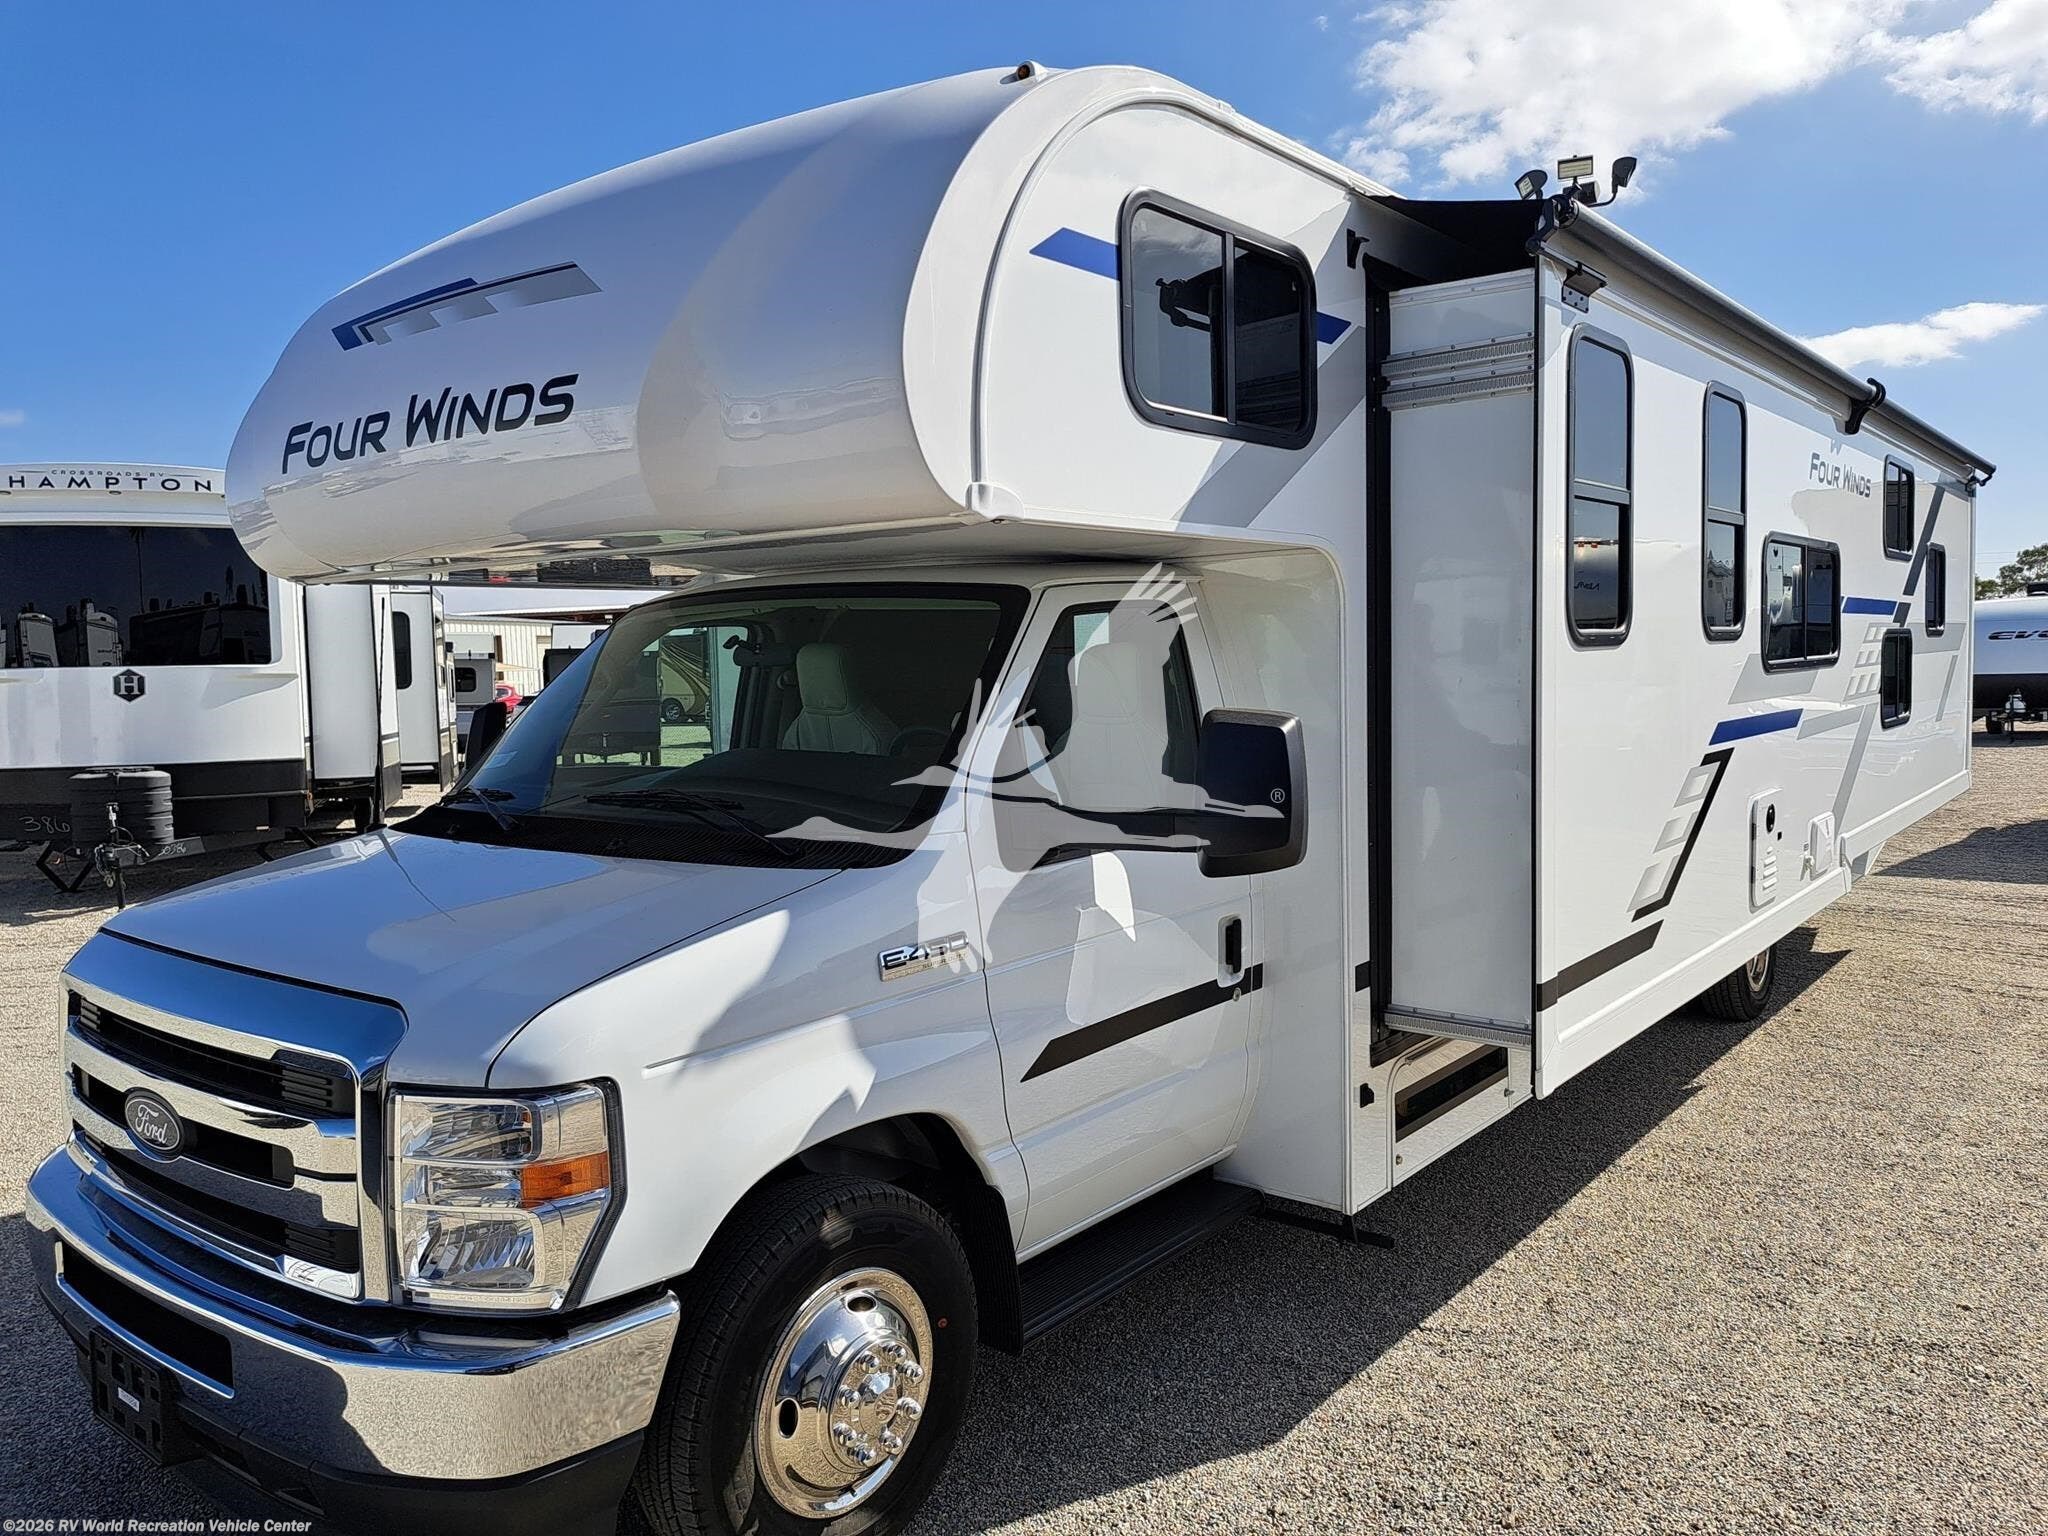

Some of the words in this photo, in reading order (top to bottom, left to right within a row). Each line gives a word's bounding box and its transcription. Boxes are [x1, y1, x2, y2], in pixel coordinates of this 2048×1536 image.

[281, 411, 391, 475] FOUR
[405, 373, 580, 448] WINDS
[8, 475, 212, 492] HAMPTON
[51, 469, 141, 477] CROSSROADS
[1809, 451, 1841, 489] FOUR
[1842, 463, 1872, 499] WINDS
[119, 674, 140, 696] H
[19, 816, 71, 834] 386
[135, 1104, 167, 1144] Ford
